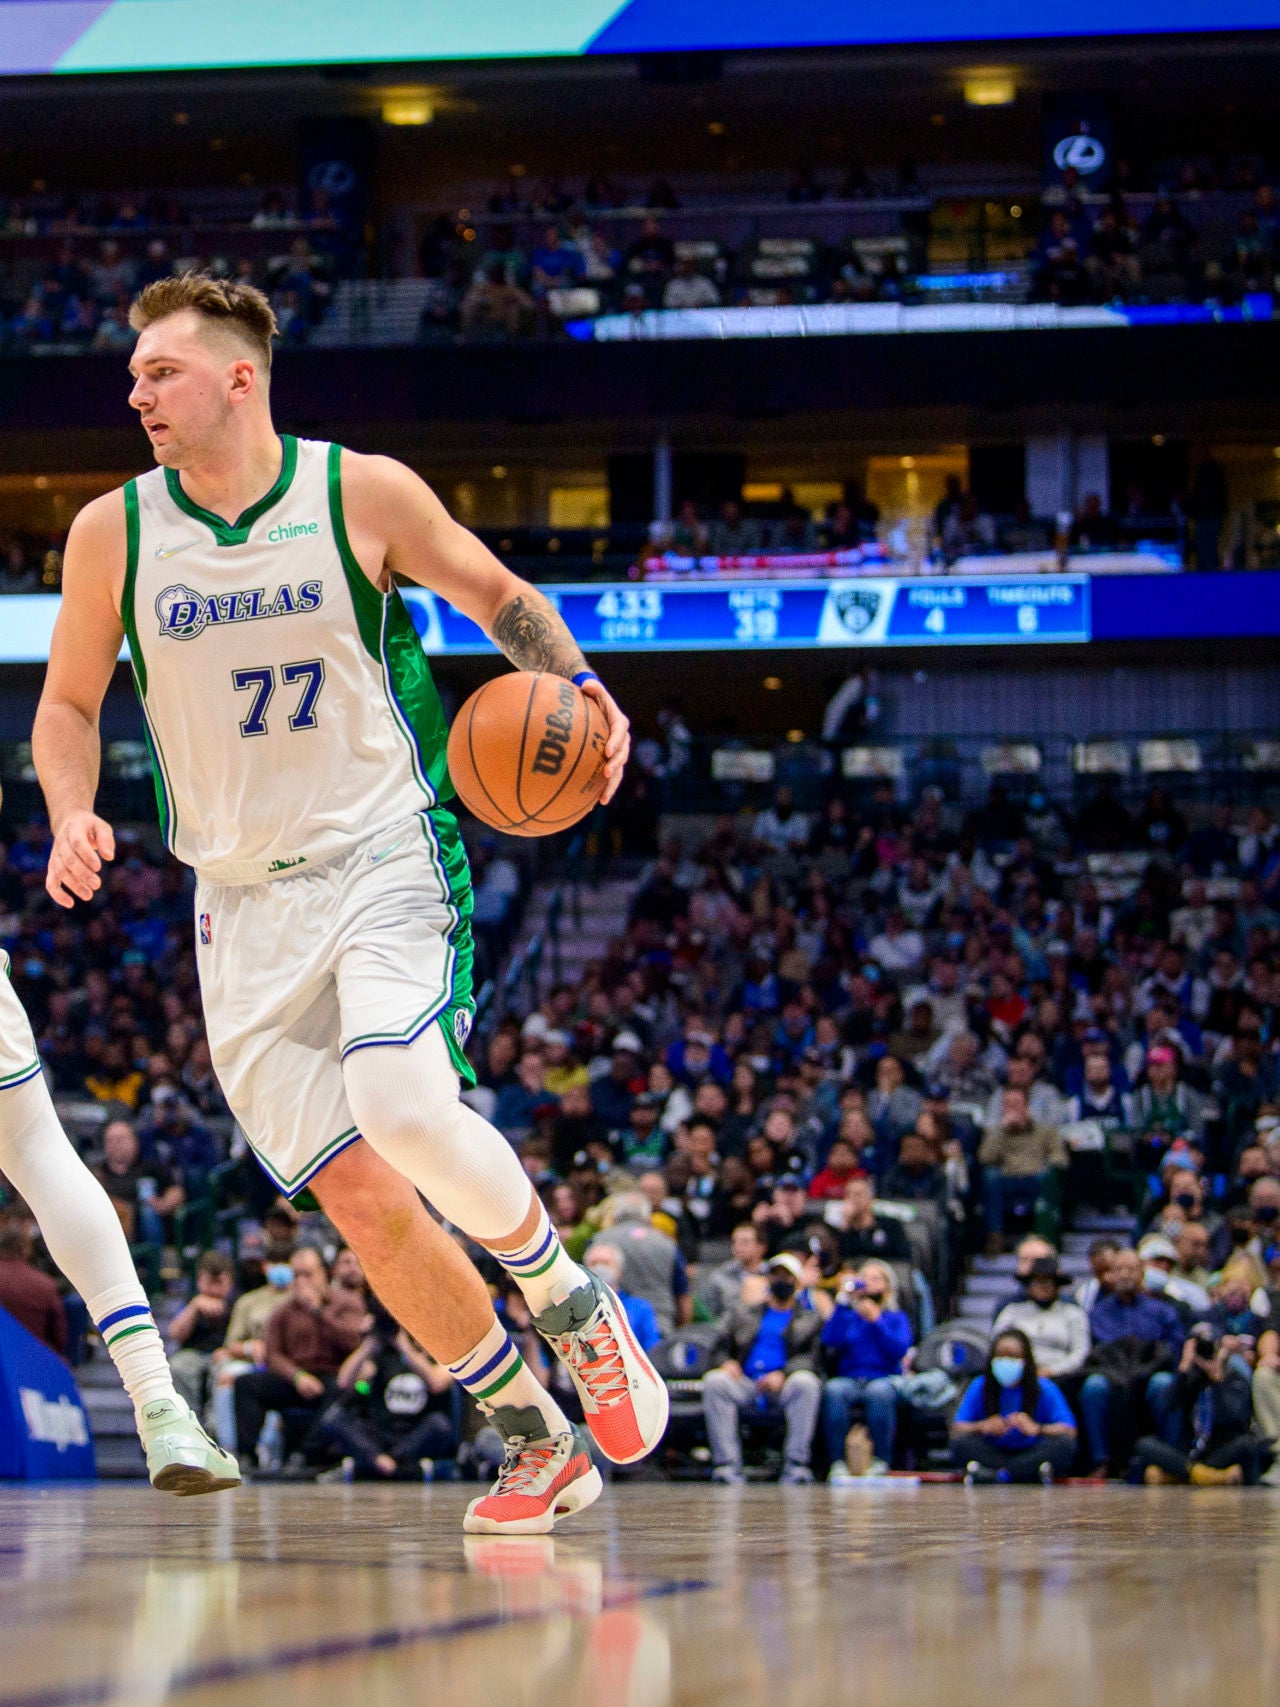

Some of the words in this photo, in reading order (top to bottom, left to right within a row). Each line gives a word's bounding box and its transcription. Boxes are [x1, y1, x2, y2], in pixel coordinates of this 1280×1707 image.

[268, 520, 319, 543] chime
[160, 581, 323, 634] DALLAS
[924, 607, 945, 633] 4
[232, 658, 325, 737] 77
[531, 683, 575, 776] Wilson
